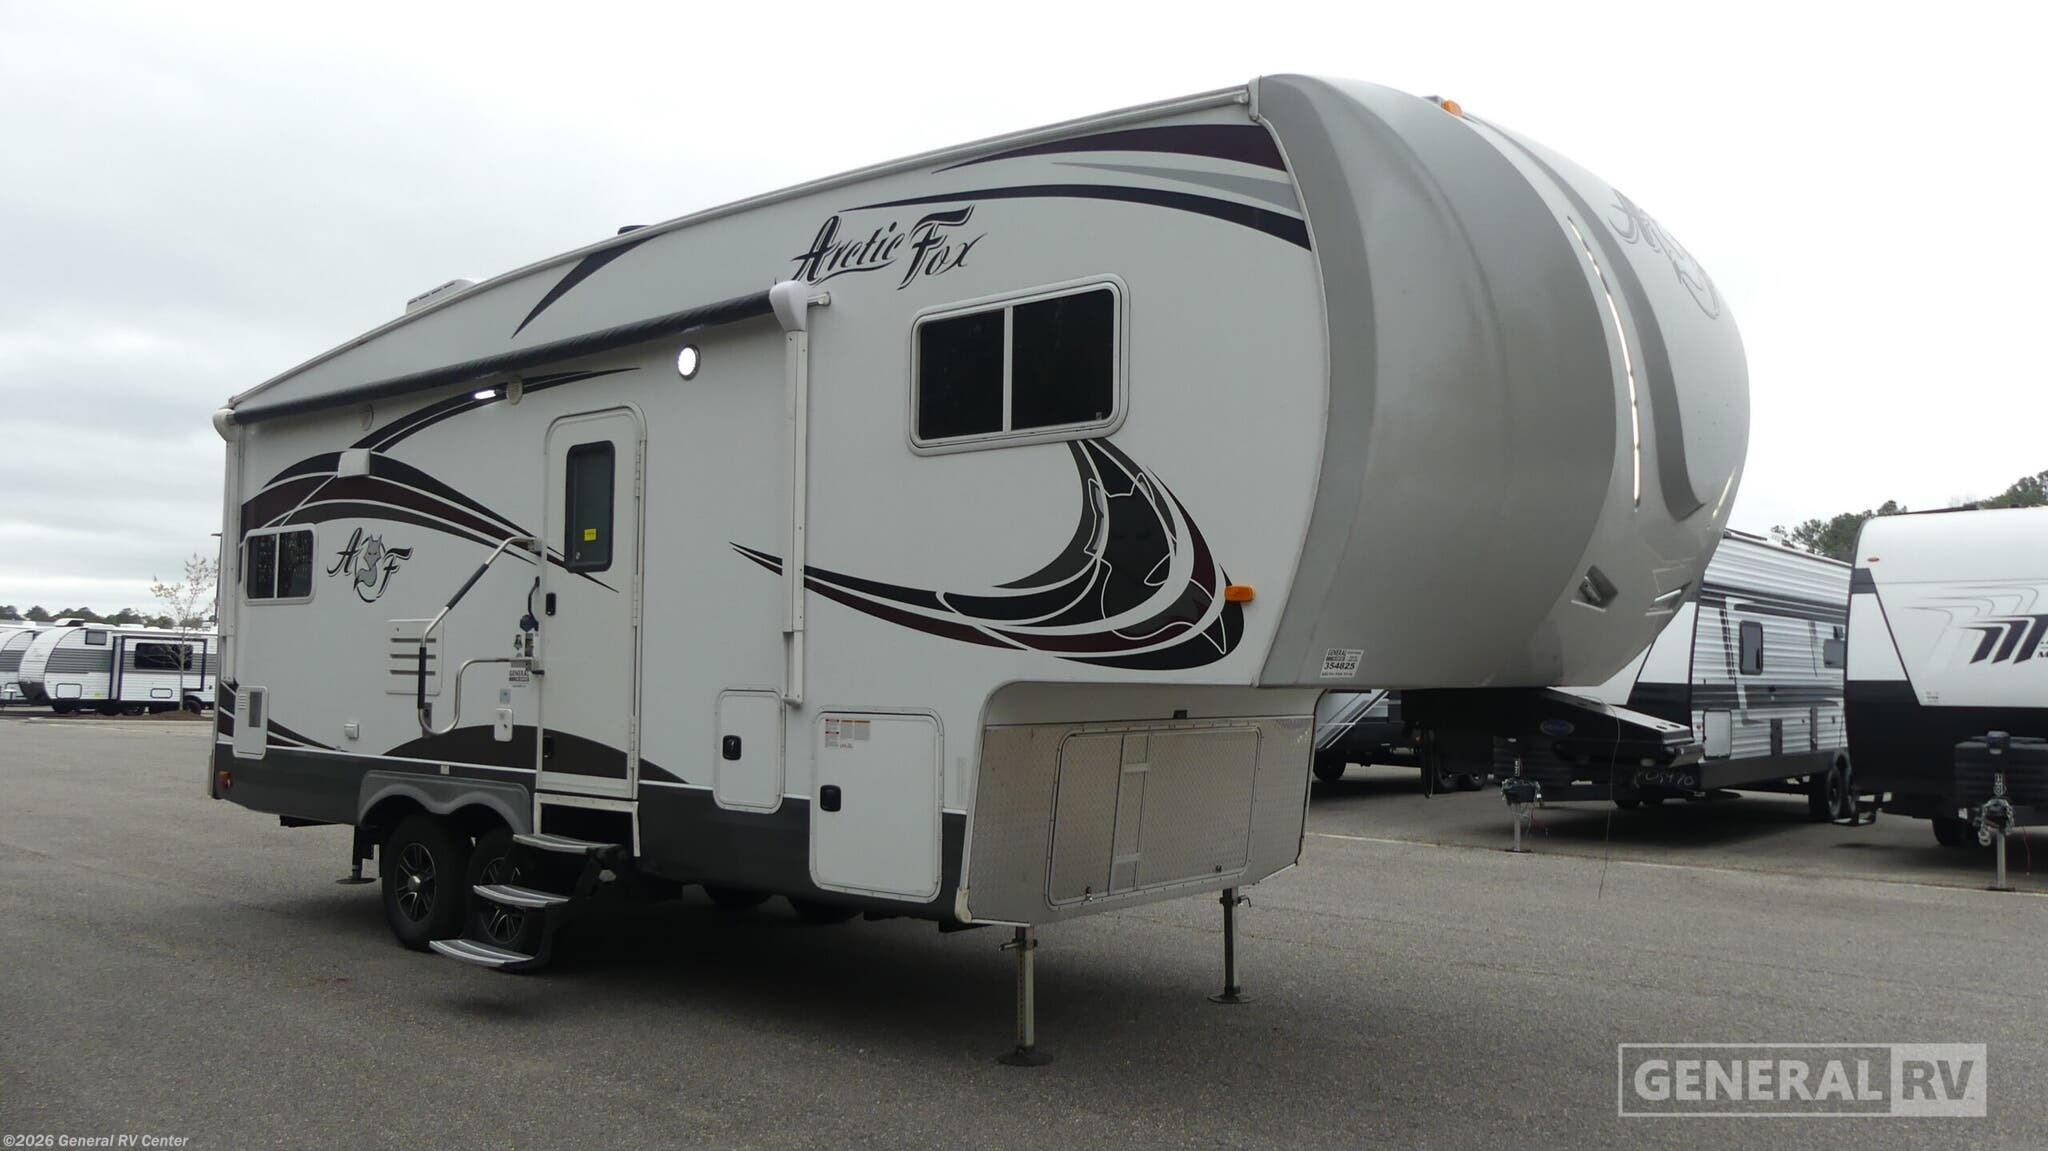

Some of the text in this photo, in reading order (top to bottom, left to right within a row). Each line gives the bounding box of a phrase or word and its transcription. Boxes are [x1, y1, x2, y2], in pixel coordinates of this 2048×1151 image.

[791, 203, 989, 290] Arctic Fox
[1324, 662, 1356, 670] 354825
